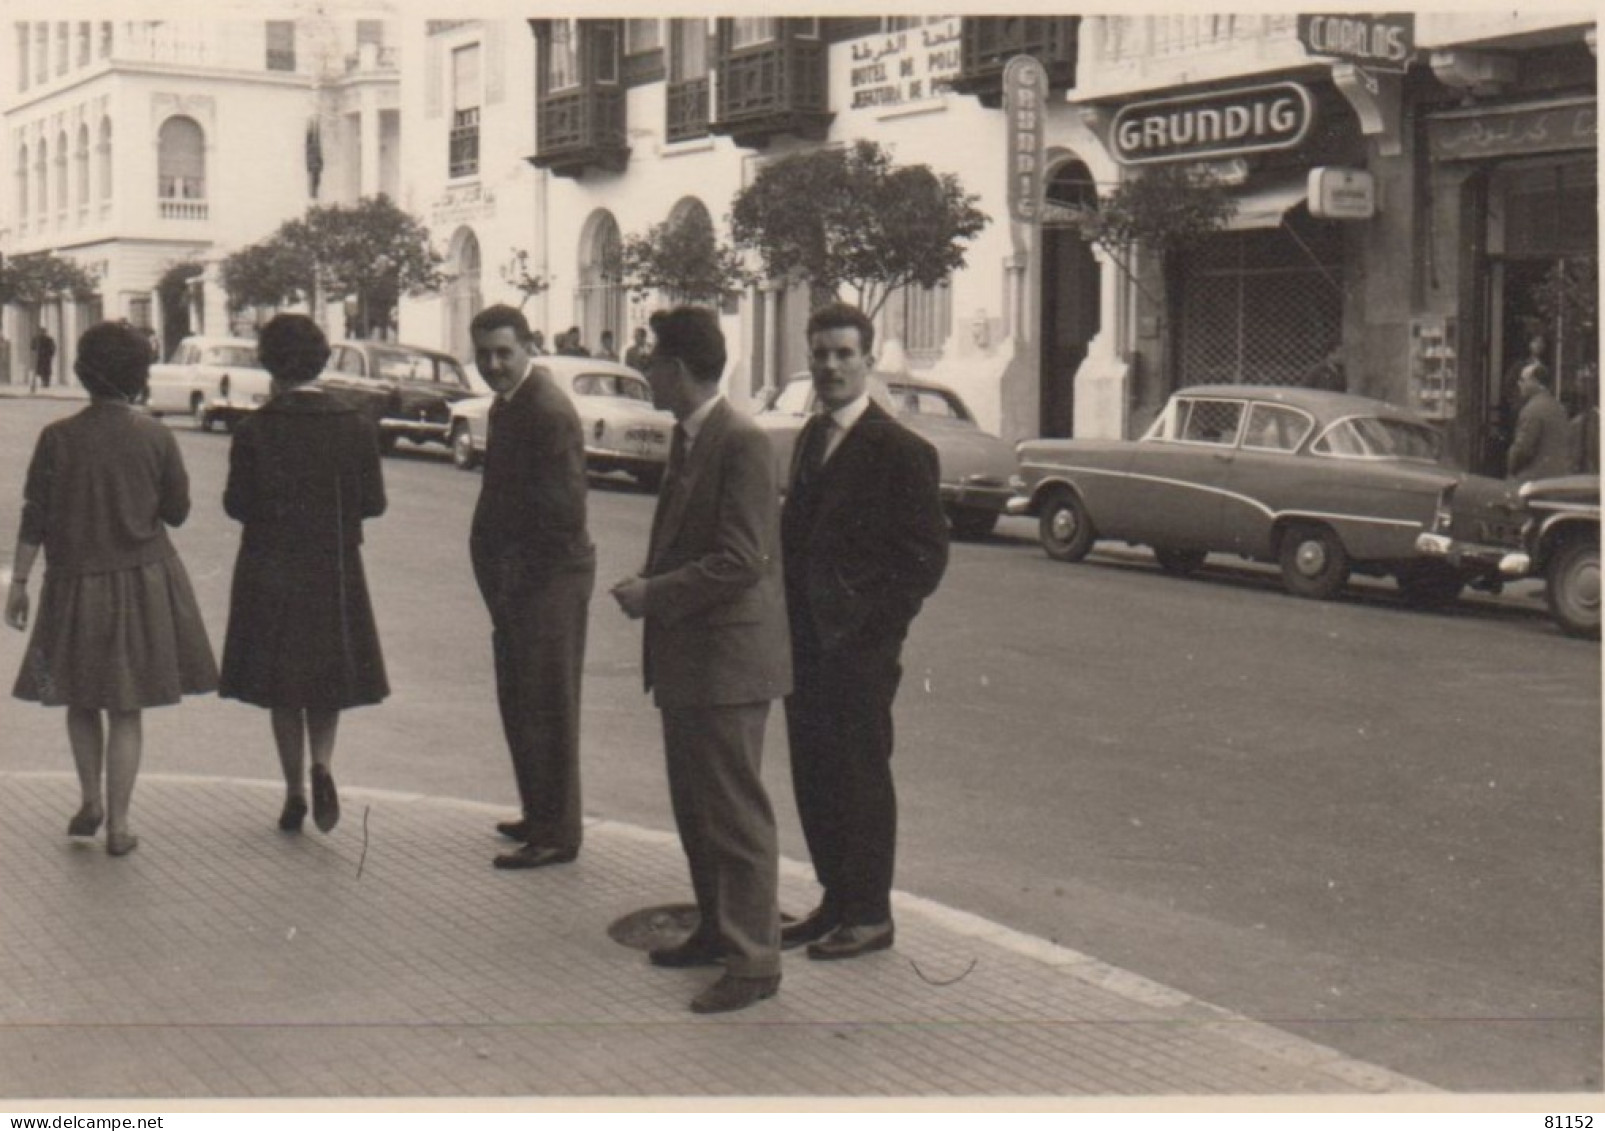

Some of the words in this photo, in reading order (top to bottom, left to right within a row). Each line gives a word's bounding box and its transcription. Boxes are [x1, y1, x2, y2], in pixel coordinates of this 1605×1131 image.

[900, 57, 914, 78] DE
[928, 50, 960, 72] POLI
[1118, 99, 1296, 150] GRUNDIG
